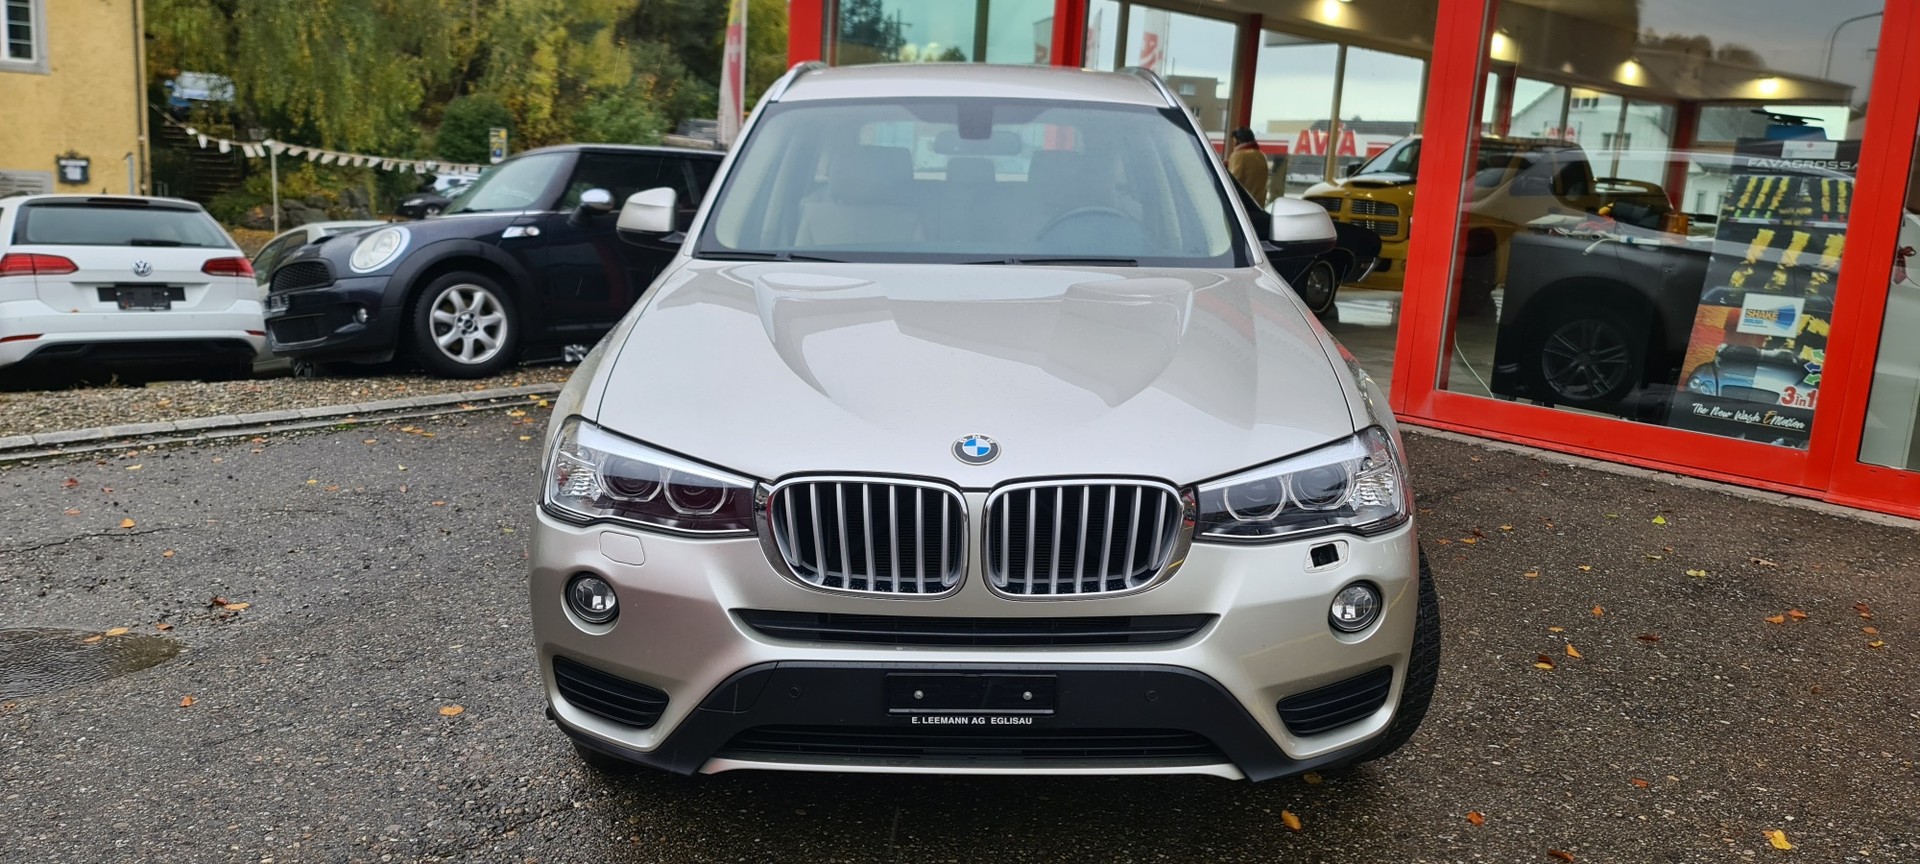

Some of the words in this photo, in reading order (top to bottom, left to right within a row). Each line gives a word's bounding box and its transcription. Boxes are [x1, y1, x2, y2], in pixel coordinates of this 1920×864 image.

[1294, 128, 1357, 157] AVA
[1692, 402, 1709, 414] The
[1710, 406, 1733, 418] New
[1734, 410, 1761, 424] Wash
[911, 716, 921, 724] E.
[922, 716, 969, 724] LEEMANN
[971, 717, 986, 725] AG
[990, 717, 1033, 725] EGLISAU
